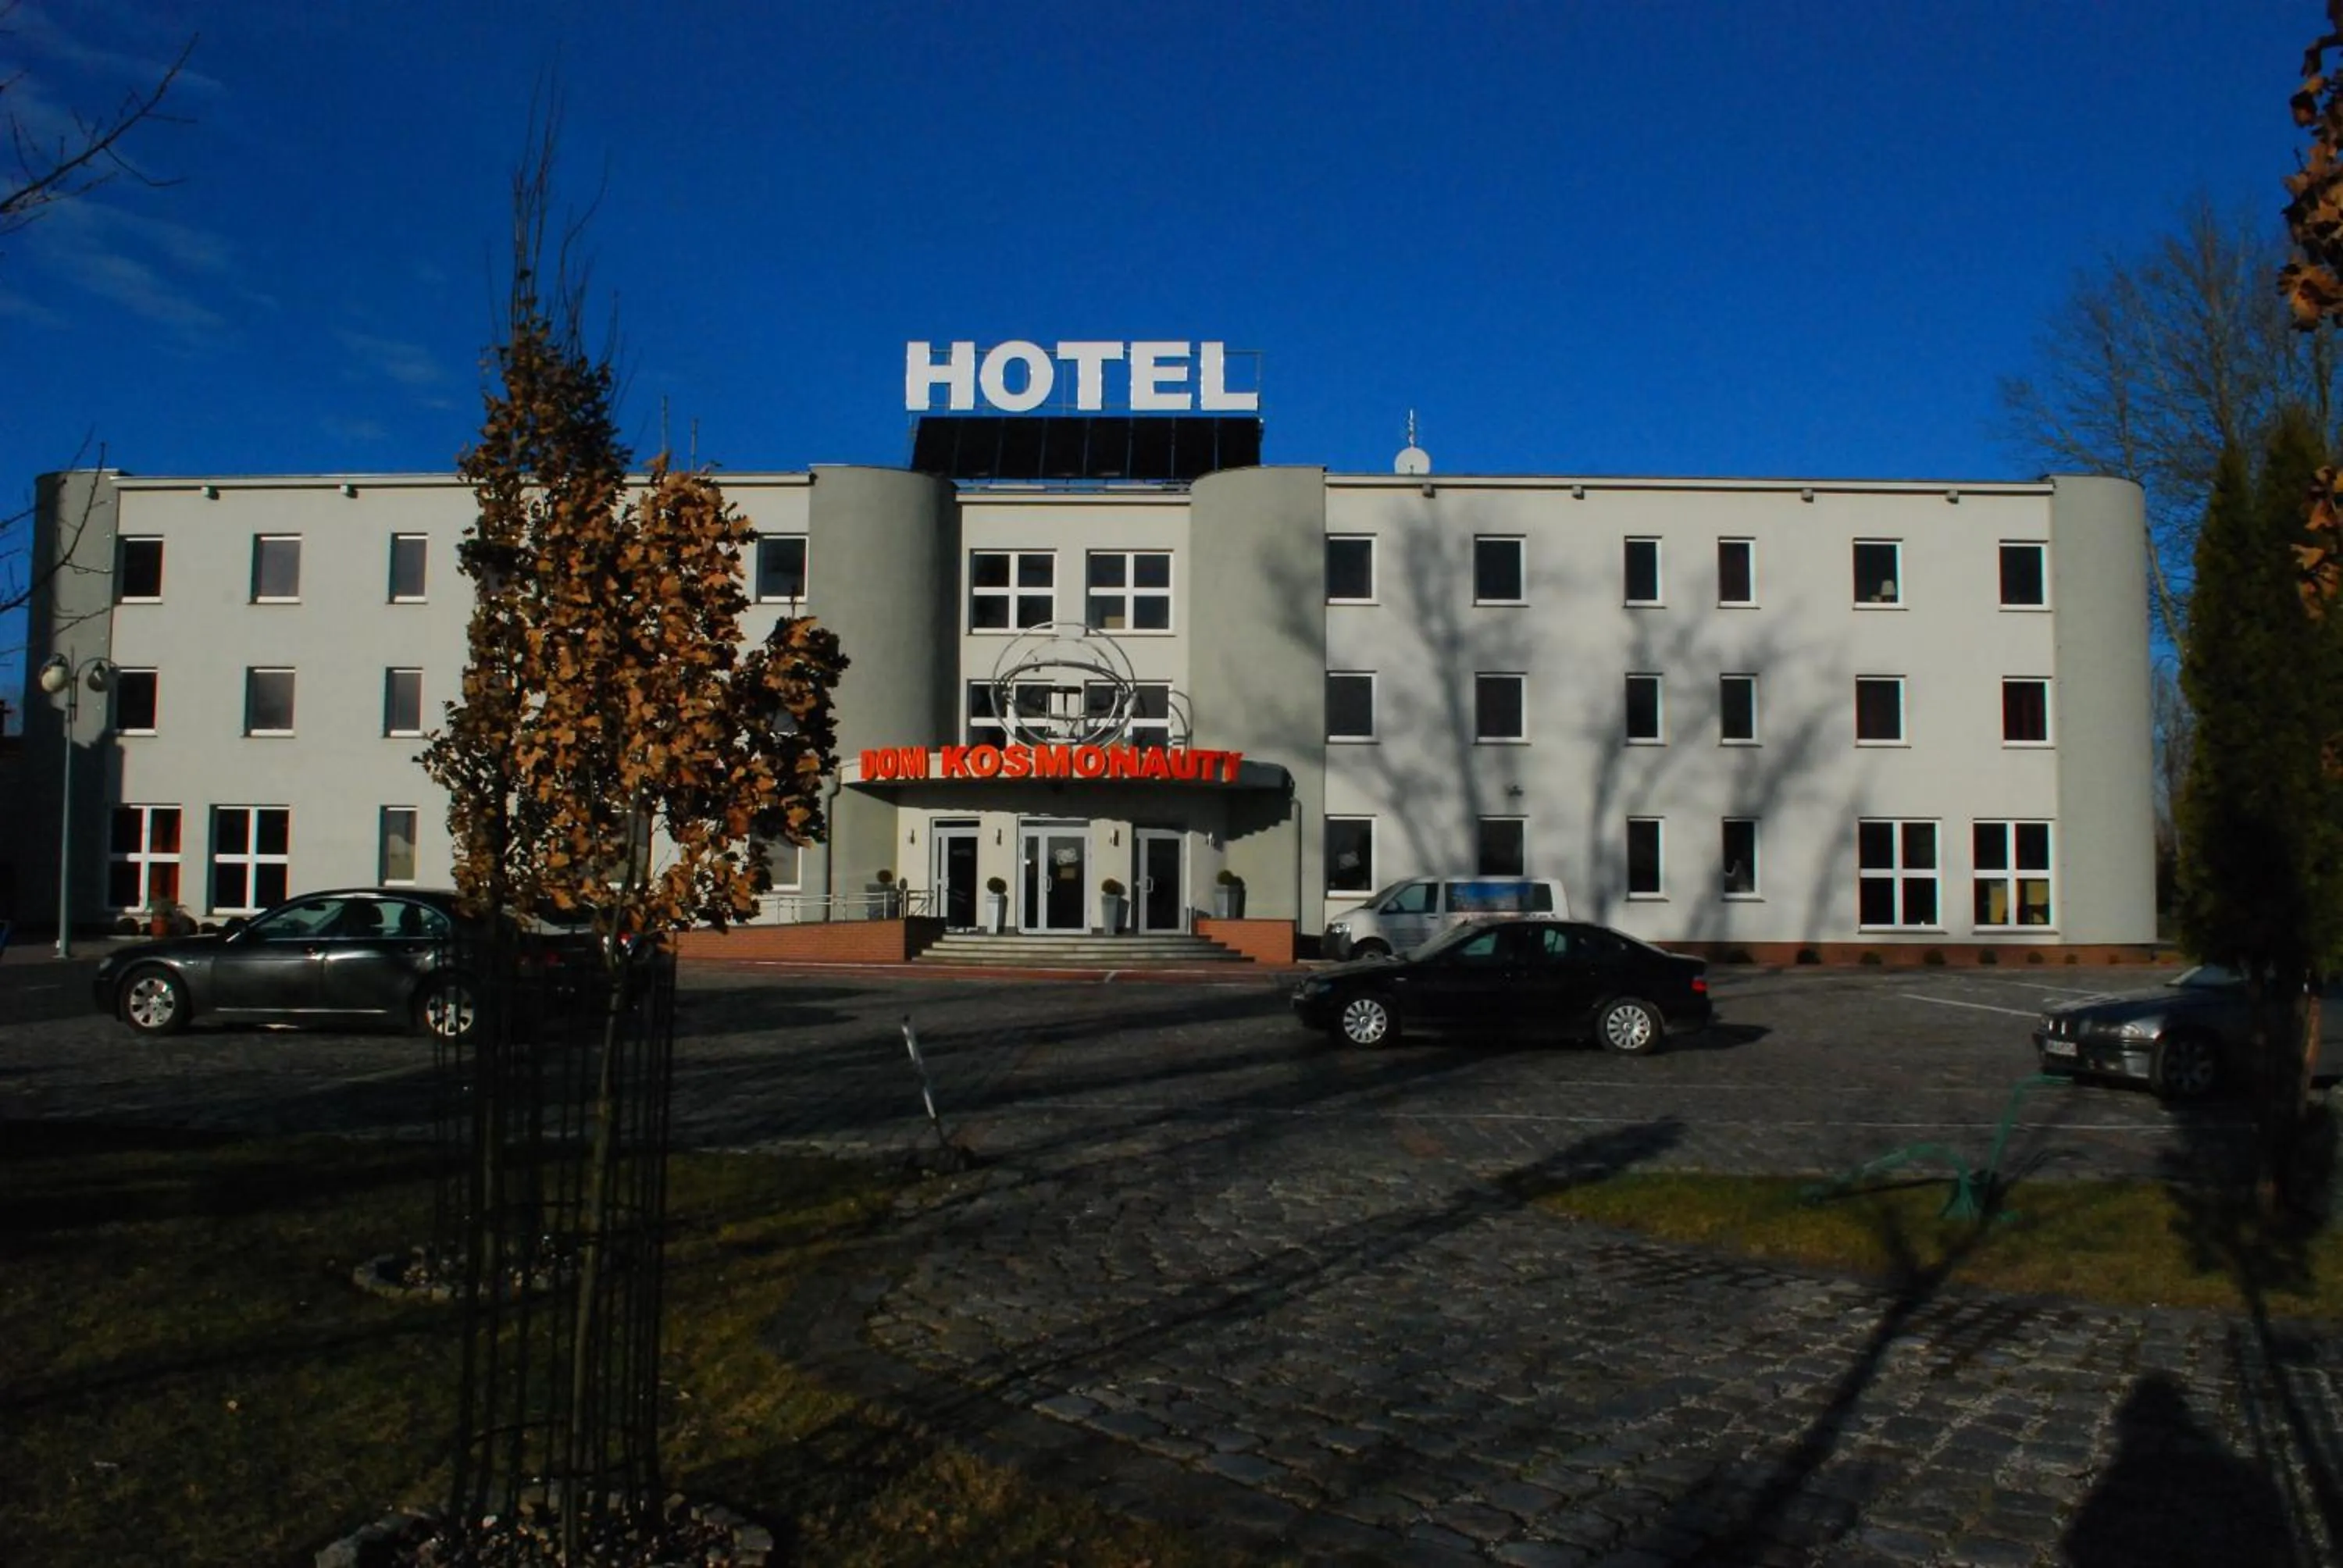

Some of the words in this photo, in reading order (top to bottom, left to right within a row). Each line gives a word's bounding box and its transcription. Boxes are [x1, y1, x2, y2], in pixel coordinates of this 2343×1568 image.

[905, 340, 1258, 412] HOTEL
[861, 746, 929, 781] DOM
[940, 744, 1243, 782] KOSMONAUTY
